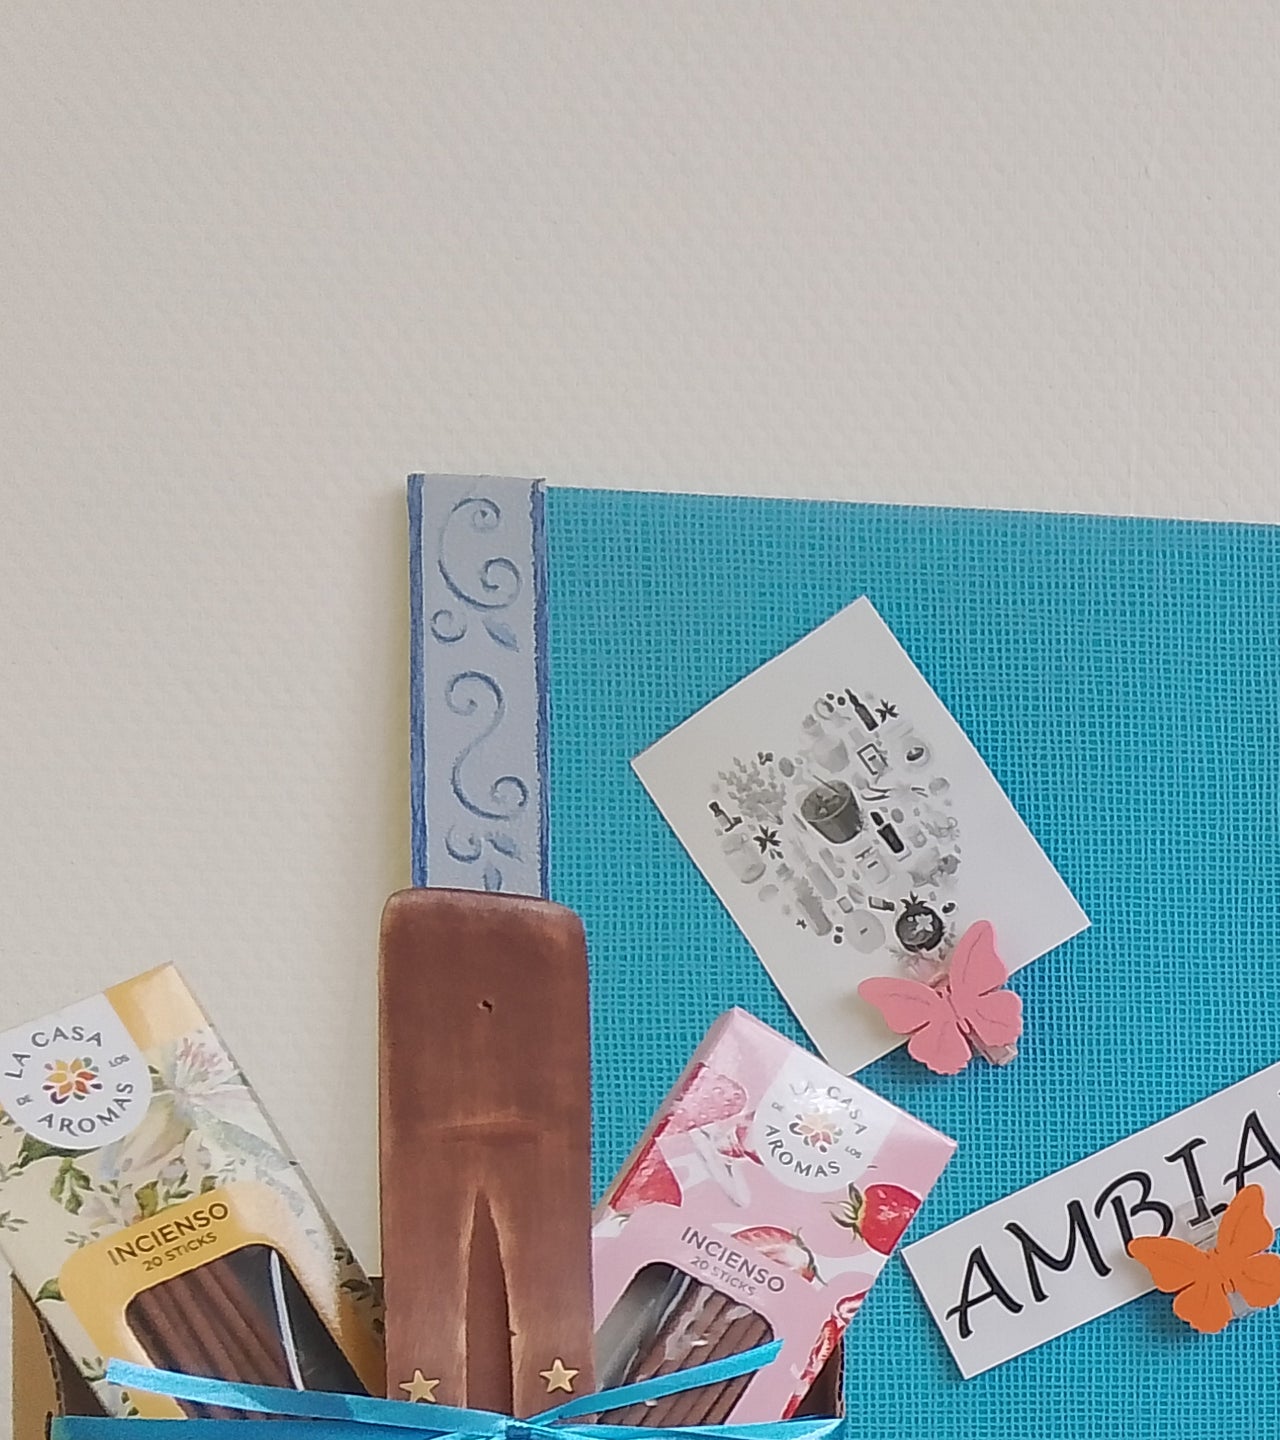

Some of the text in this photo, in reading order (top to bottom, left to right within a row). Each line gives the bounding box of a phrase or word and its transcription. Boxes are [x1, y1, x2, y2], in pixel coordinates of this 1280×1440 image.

[4, 1026, 102, 1079] LA CASA
[37, 1083, 134, 1138] AROMAS
[827, 1086, 868, 1135] CASA
[765, 1124, 841, 1178] AROMAS
[107, 1202, 228, 1266] INCIENSO
[142, 1232, 218, 1271] 20 STICKS
[681, 1226, 785, 1292] INCIENSO
[690, 1256, 757, 1296] 20 STICKS
